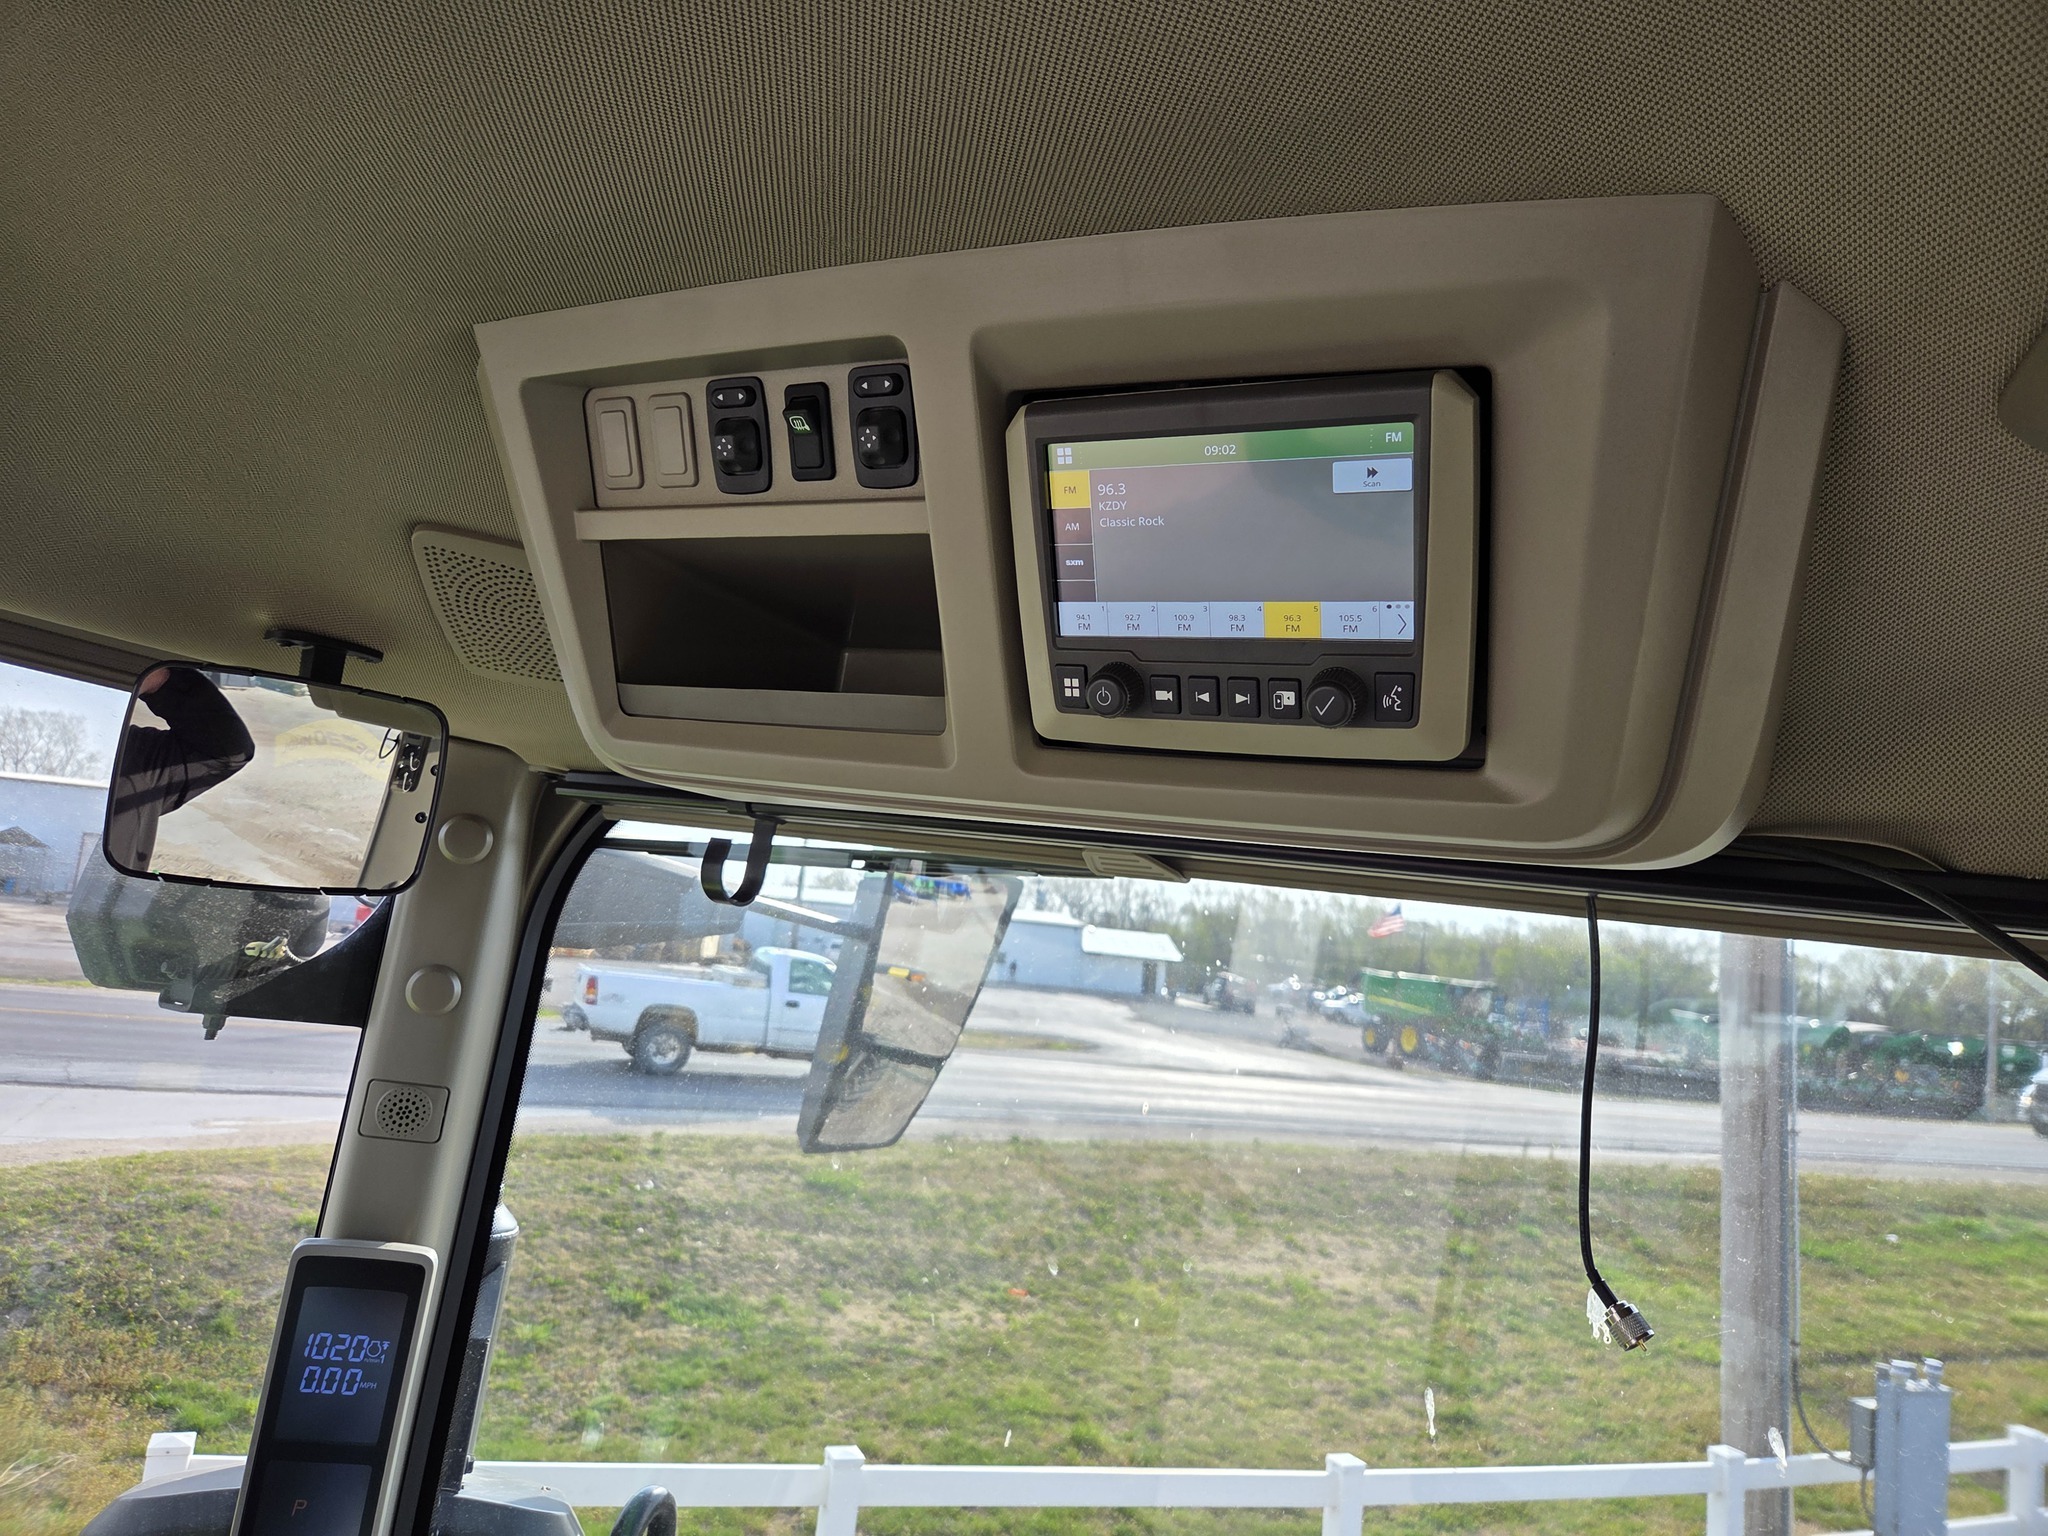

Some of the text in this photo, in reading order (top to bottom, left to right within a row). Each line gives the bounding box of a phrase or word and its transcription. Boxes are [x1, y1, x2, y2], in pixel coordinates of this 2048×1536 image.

[1385, 431, 1402, 443] FM
[1204, 444, 1236, 456] 09:02
[1362, 480, 1382, 488] Scan
[1063, 485, 1077, 495] FM
[1097, 482, 1126, 496] 96.3
[1098, 501, 1127, 512] KZDY
[1099, 515, 1165, 528] Classic Rock
[1065, 522, 1080, 531] AM
[1065, 559, 1084, 567] sxm
[1075, 613, 1091, 621] 94.1
[1173, 614, 1195, 622] 100.9
[1228, 614, 1246, 622] 98.3
[1283, 614, 1302, 622] 96.3
[1338, 614, 1363, 622] 105.5
[1077, 622, 1091, 631] FM
[1126, 623, 1140, 631] FM
[1177, 623, 1192, 632] FM
[1230, 624, 1245, 632] FM
[1285, 624, 1301, 632] FM
[1343, 624, 1358, 633] FM
[303, 1332, 370, 1363] 1020
[299, 1365, 377, 1396] 0.00 MPH
[291, 1499, 308, 1517] P
